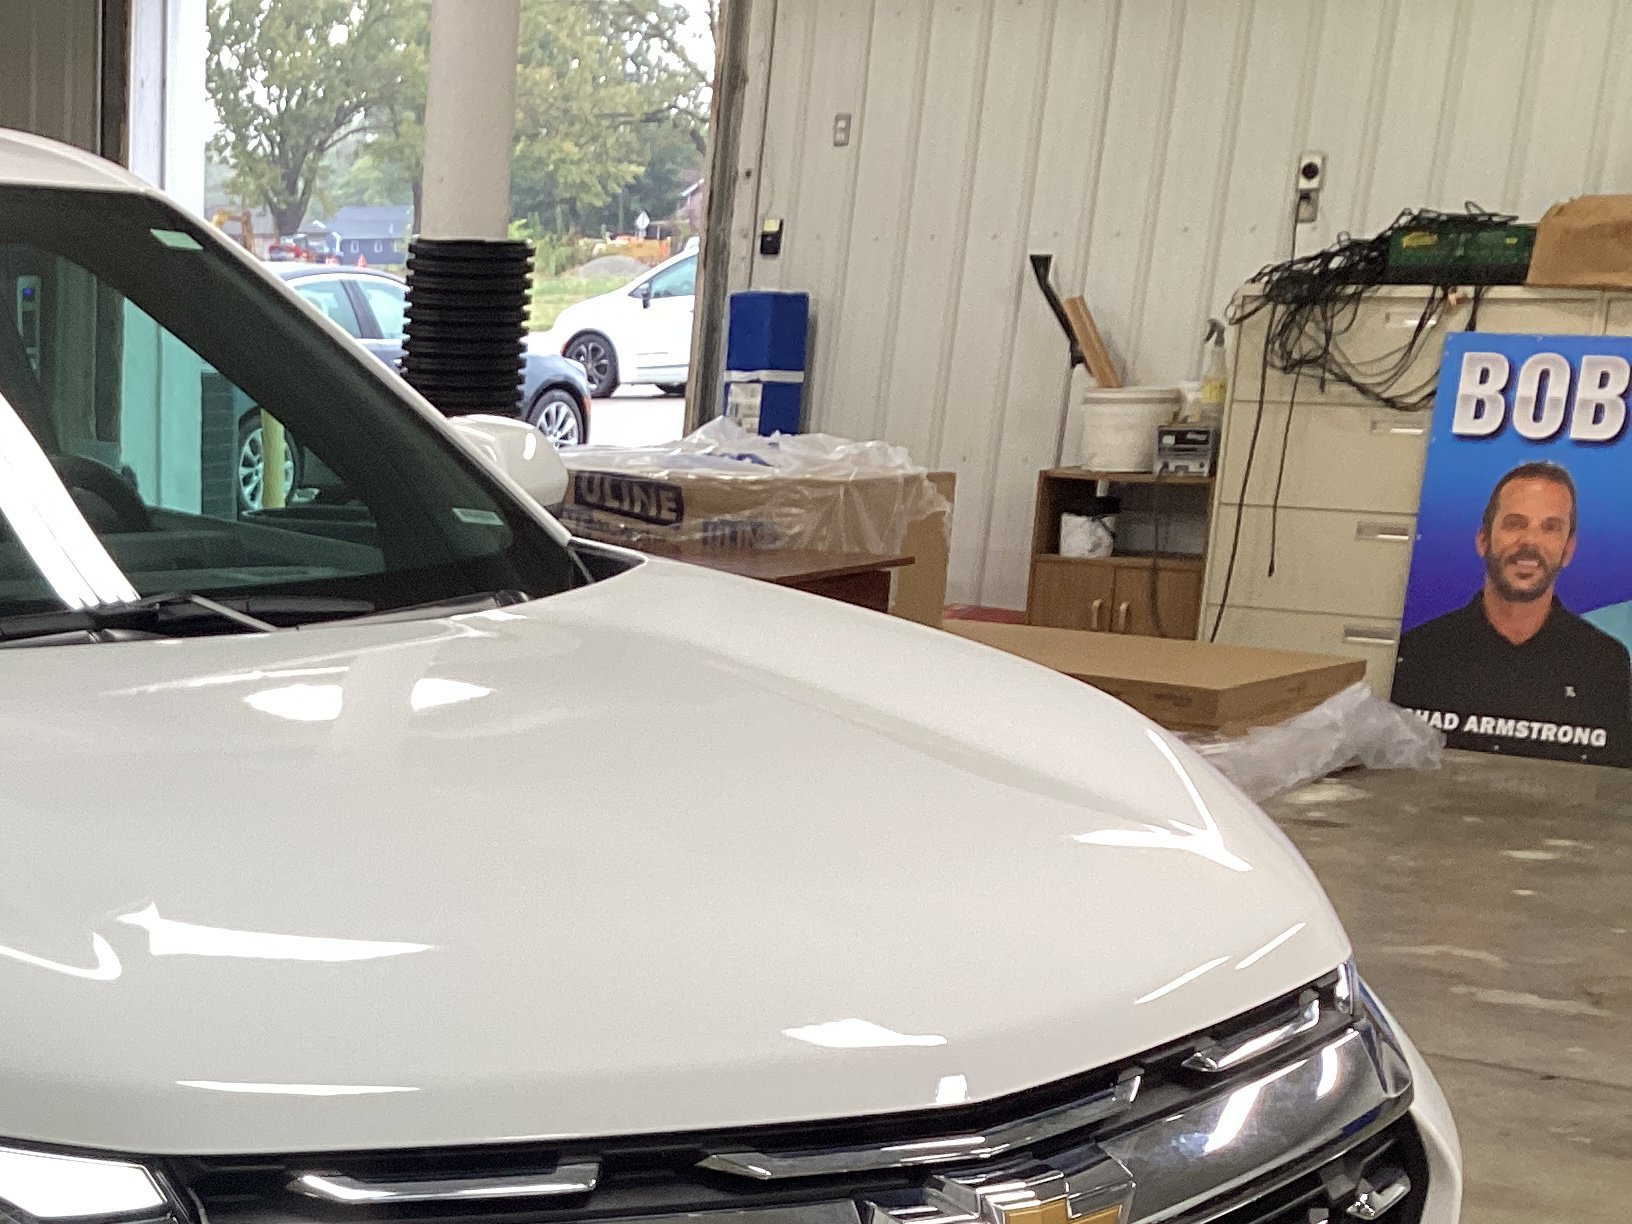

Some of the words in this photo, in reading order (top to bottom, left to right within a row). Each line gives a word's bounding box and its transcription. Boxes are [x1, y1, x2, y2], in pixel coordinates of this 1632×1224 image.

[1452, 351, 1631, 442] BOB
[578, 472, 680, 523] ULINE
[1406, 708, 1460, 730] HAD
[1463, 715, 1608, 747] ARMSTRONG
